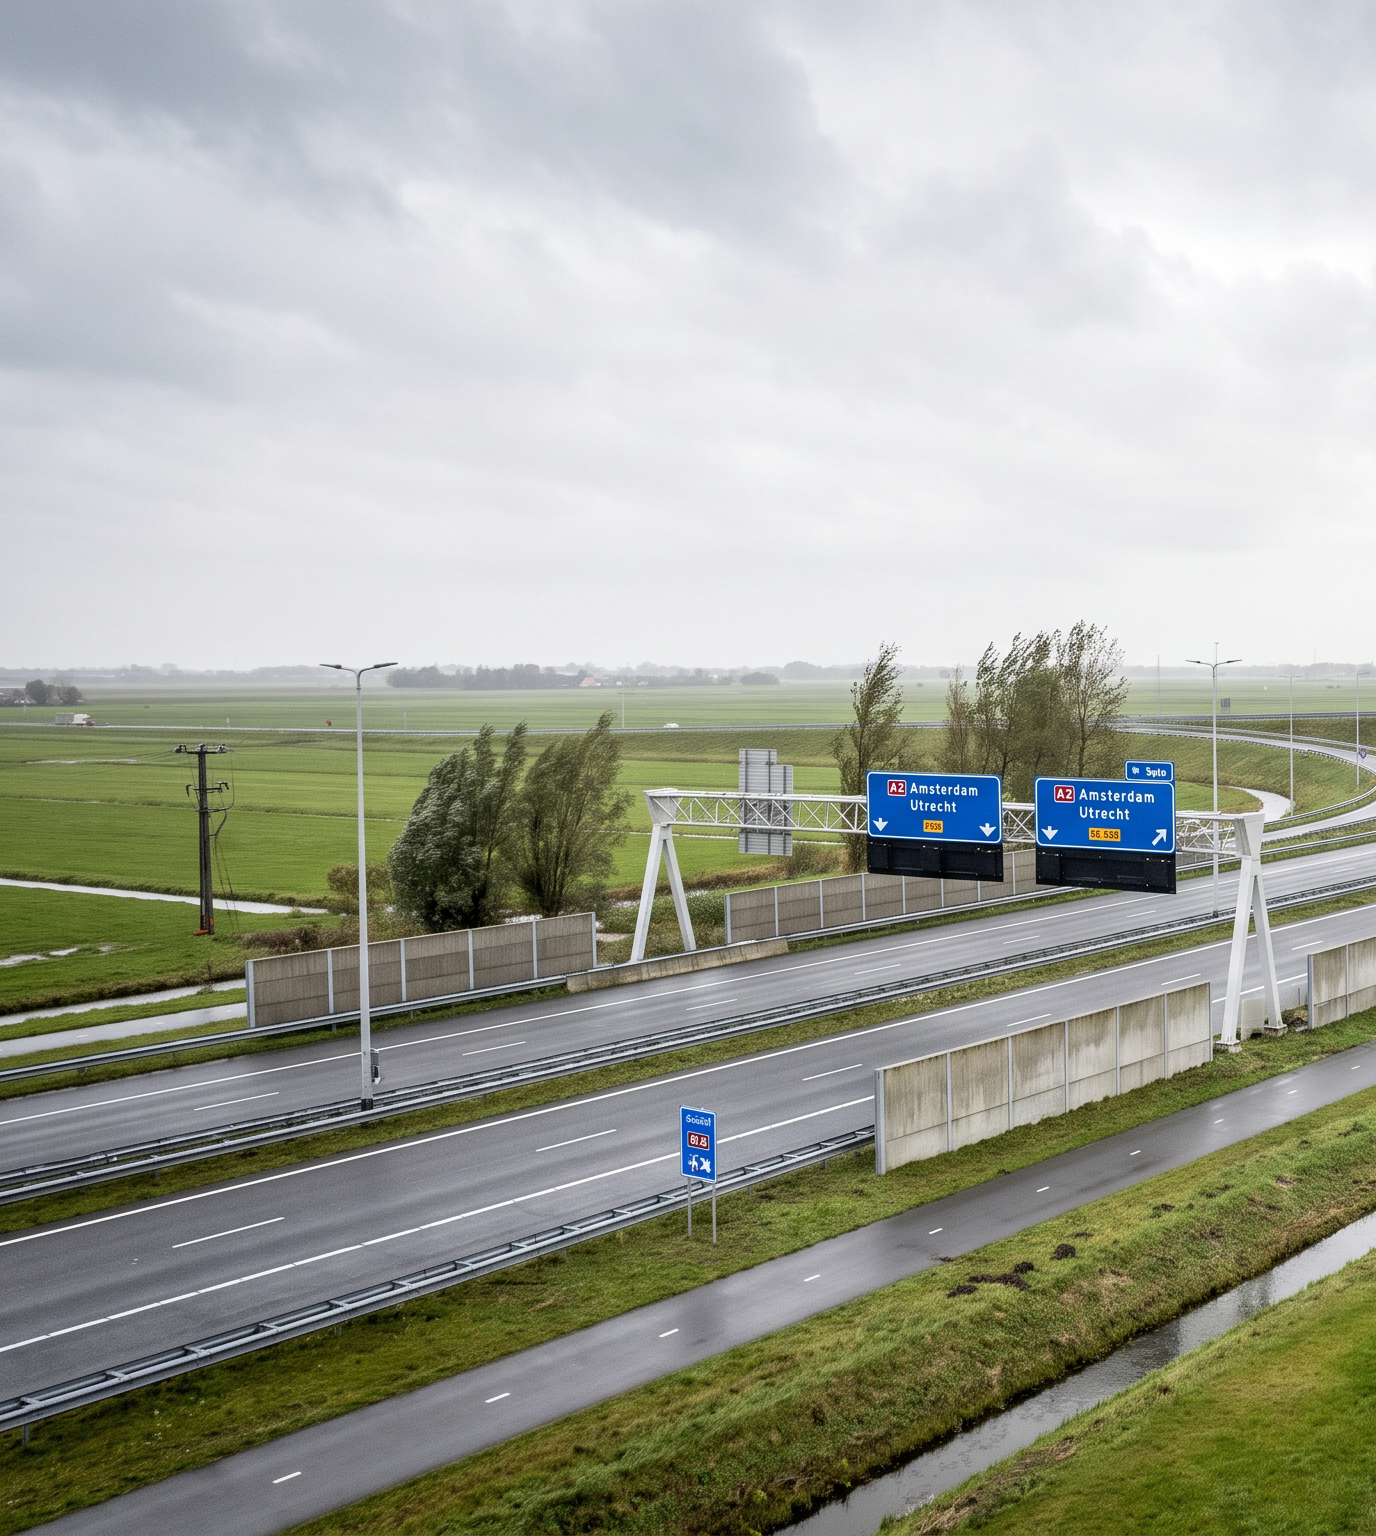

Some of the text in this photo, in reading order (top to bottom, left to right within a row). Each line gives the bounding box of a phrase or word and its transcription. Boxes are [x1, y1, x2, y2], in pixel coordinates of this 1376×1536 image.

[889, 782, 979, 796] A2 Amsterdam
[1056, 788, 1155, 803] A2 Amsterdam
[910, 799, 957, 812] Utrecht
[1079, 806, 1130, 820] Utrecht
